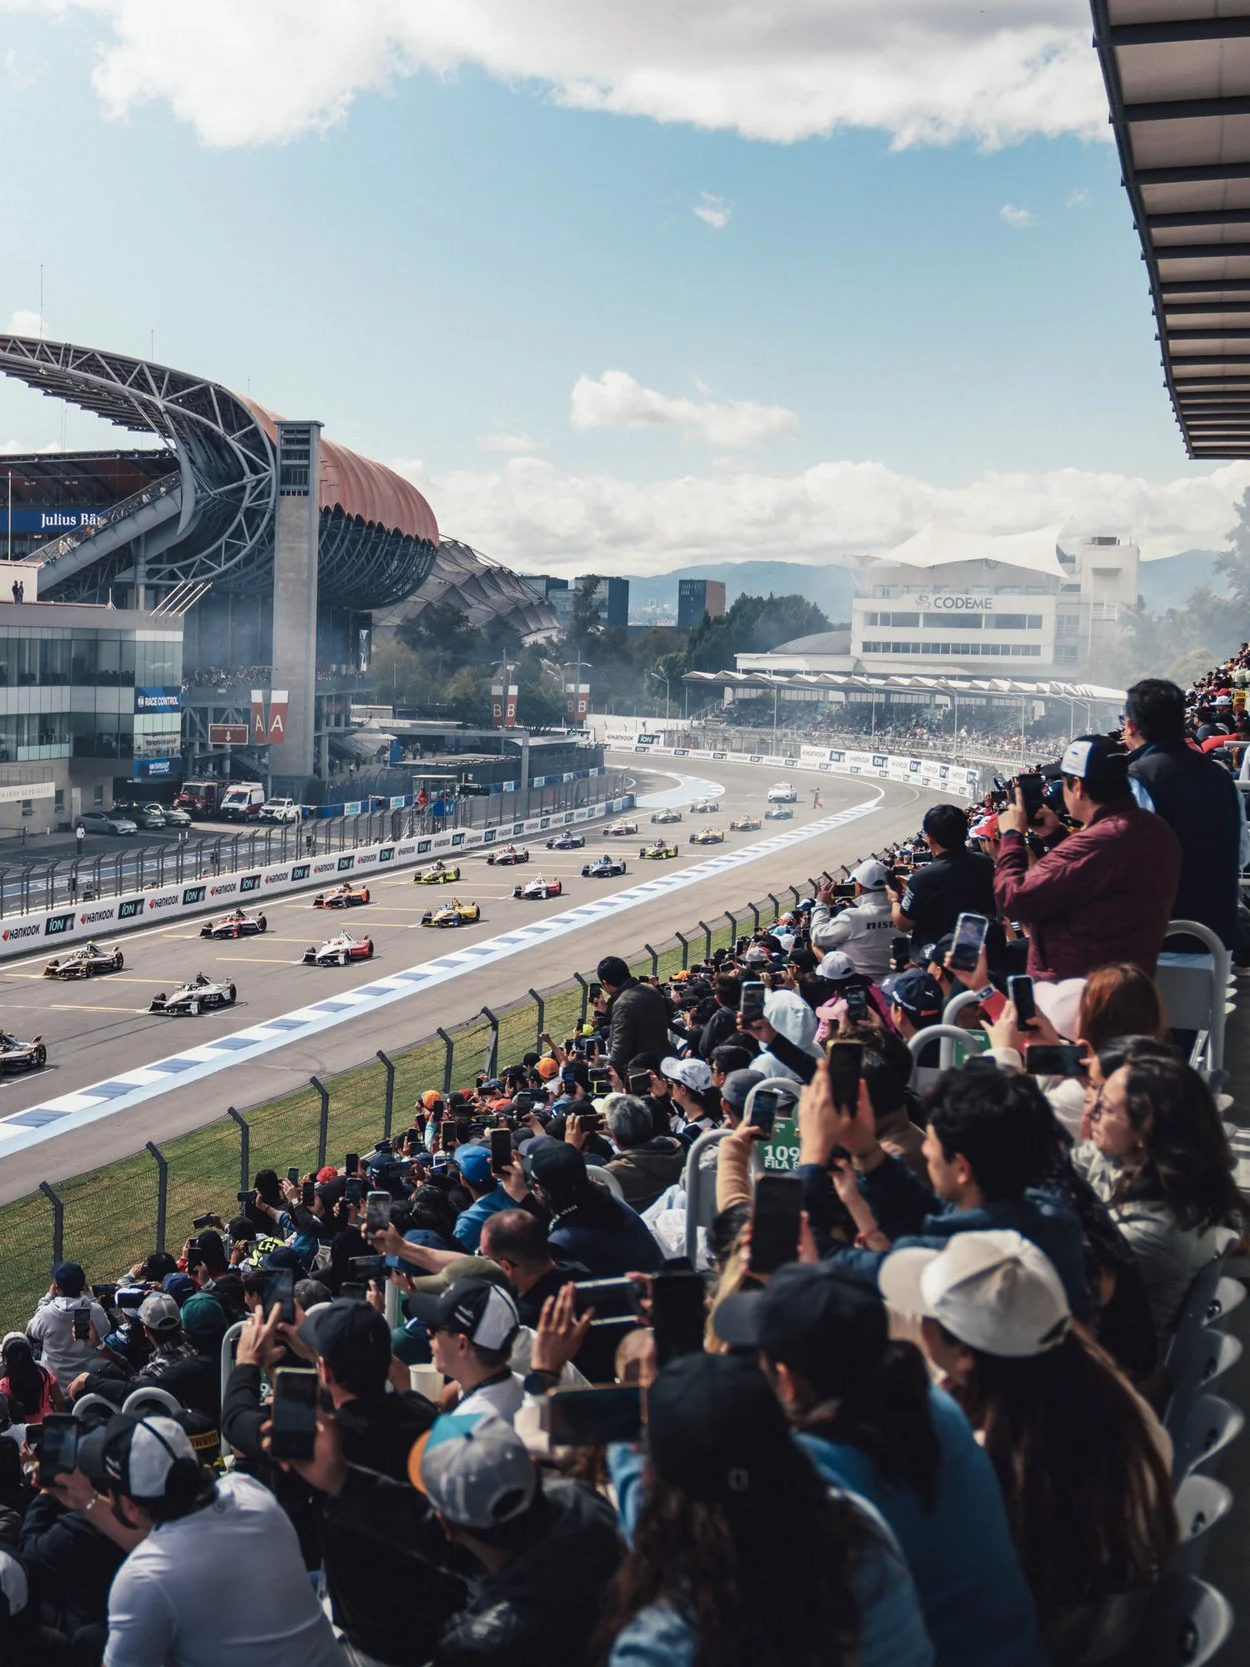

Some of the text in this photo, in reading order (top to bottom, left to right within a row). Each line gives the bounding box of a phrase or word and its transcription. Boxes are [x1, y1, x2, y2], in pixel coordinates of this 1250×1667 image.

[41, 514, 76, 528] Julius
[934, 597, 992, 609] CODEME
[145, 697, 157, 706] RACE
[158, 696, 178, 706] CONTROL
[578, 701, 586, 712] B
[494, 704, 502, 717] B
[508, 704, 514, 717] B
[256, 714, 263, 732] A
[270, 714, 283, 732] A
[49, 918, 64, 932] iON
[121, 904, 134, 916] iON
[185, 891, 198, 901] iON
[242, 878, 253, 888] iON
[764, 1145, 800, 1162] 109
[764, 1160, 789, 1169] FILA
